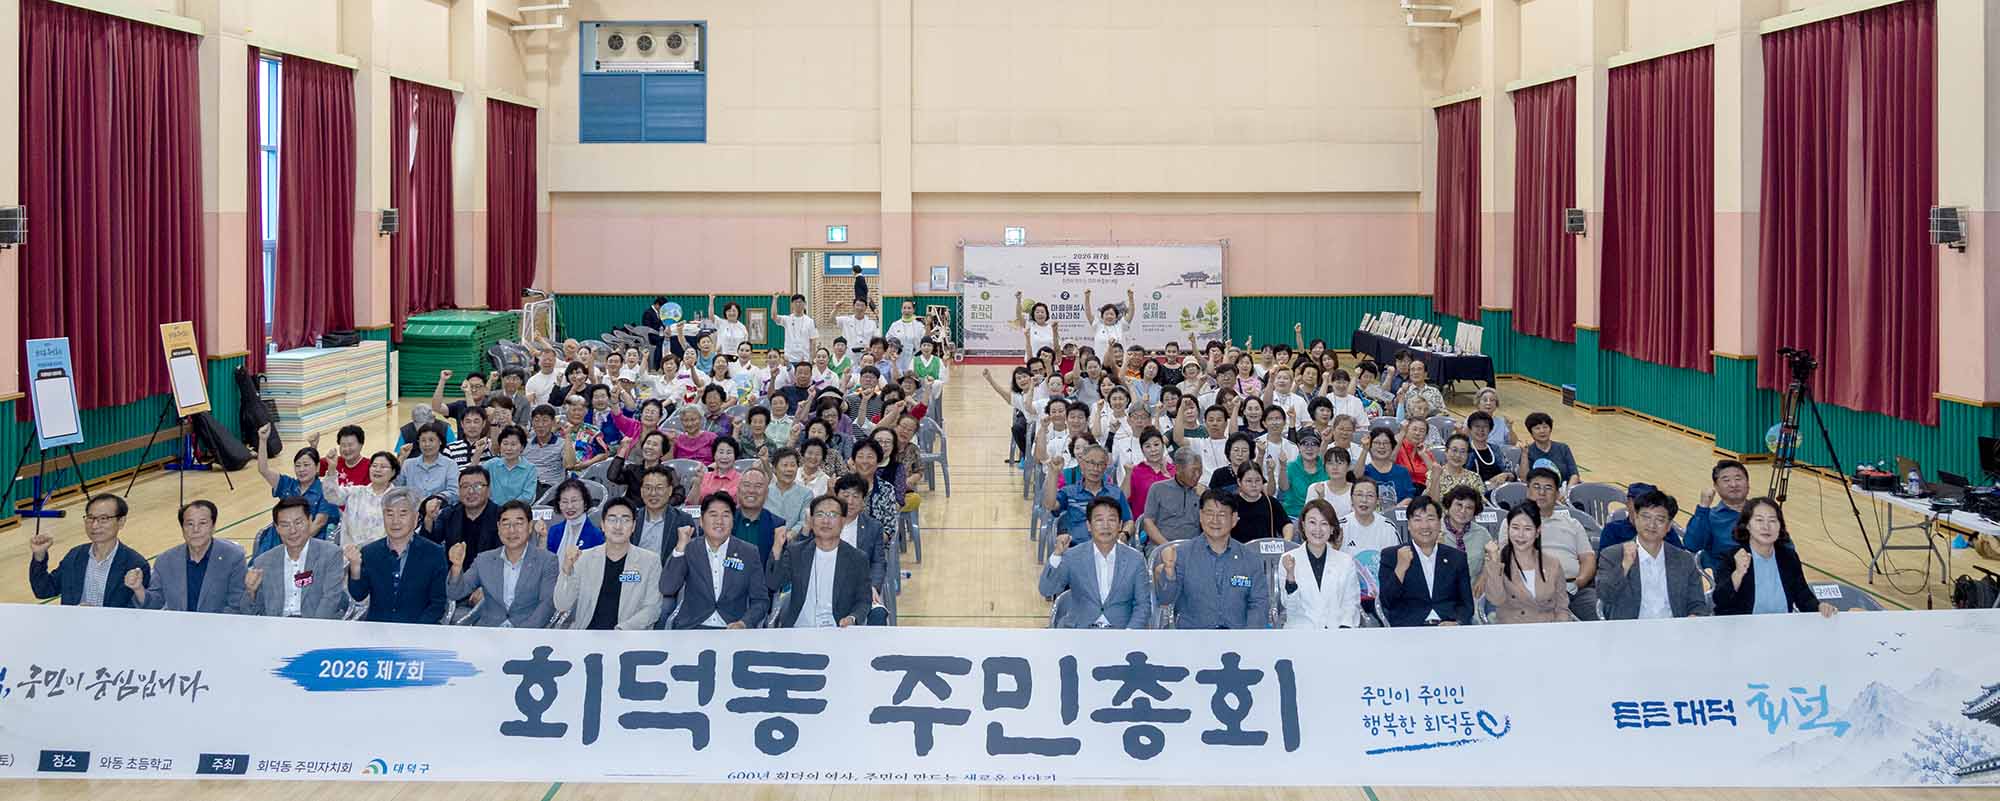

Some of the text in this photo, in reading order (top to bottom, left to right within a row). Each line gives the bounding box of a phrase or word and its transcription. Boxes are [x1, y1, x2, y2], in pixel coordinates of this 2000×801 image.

[1040, 262, 1139, 275] 회덕동 주민총회
[319, 660, 425, 681] 2026 제7회
[17, 664, 84, 699] 주민이
[85, 667, 209, 703] 중심입니다
[500, 645, 1301, 760] 회덕동 주민총회
[1361, 685, 1465, 706] 주민이 주인인
[1673, 699, 1737, 726] 대덕
[1746, 683, 1851, 737] 회덕
[1362, 711, 1475, 738] 행복한 회덕동
[52, 754, 77, 768] 장소
[100, 756, 173, 771] 와동 초등학교
[211, 757, 236, 772] 주최
[256, 760, 353, 774] 회덕동 주민자치회
